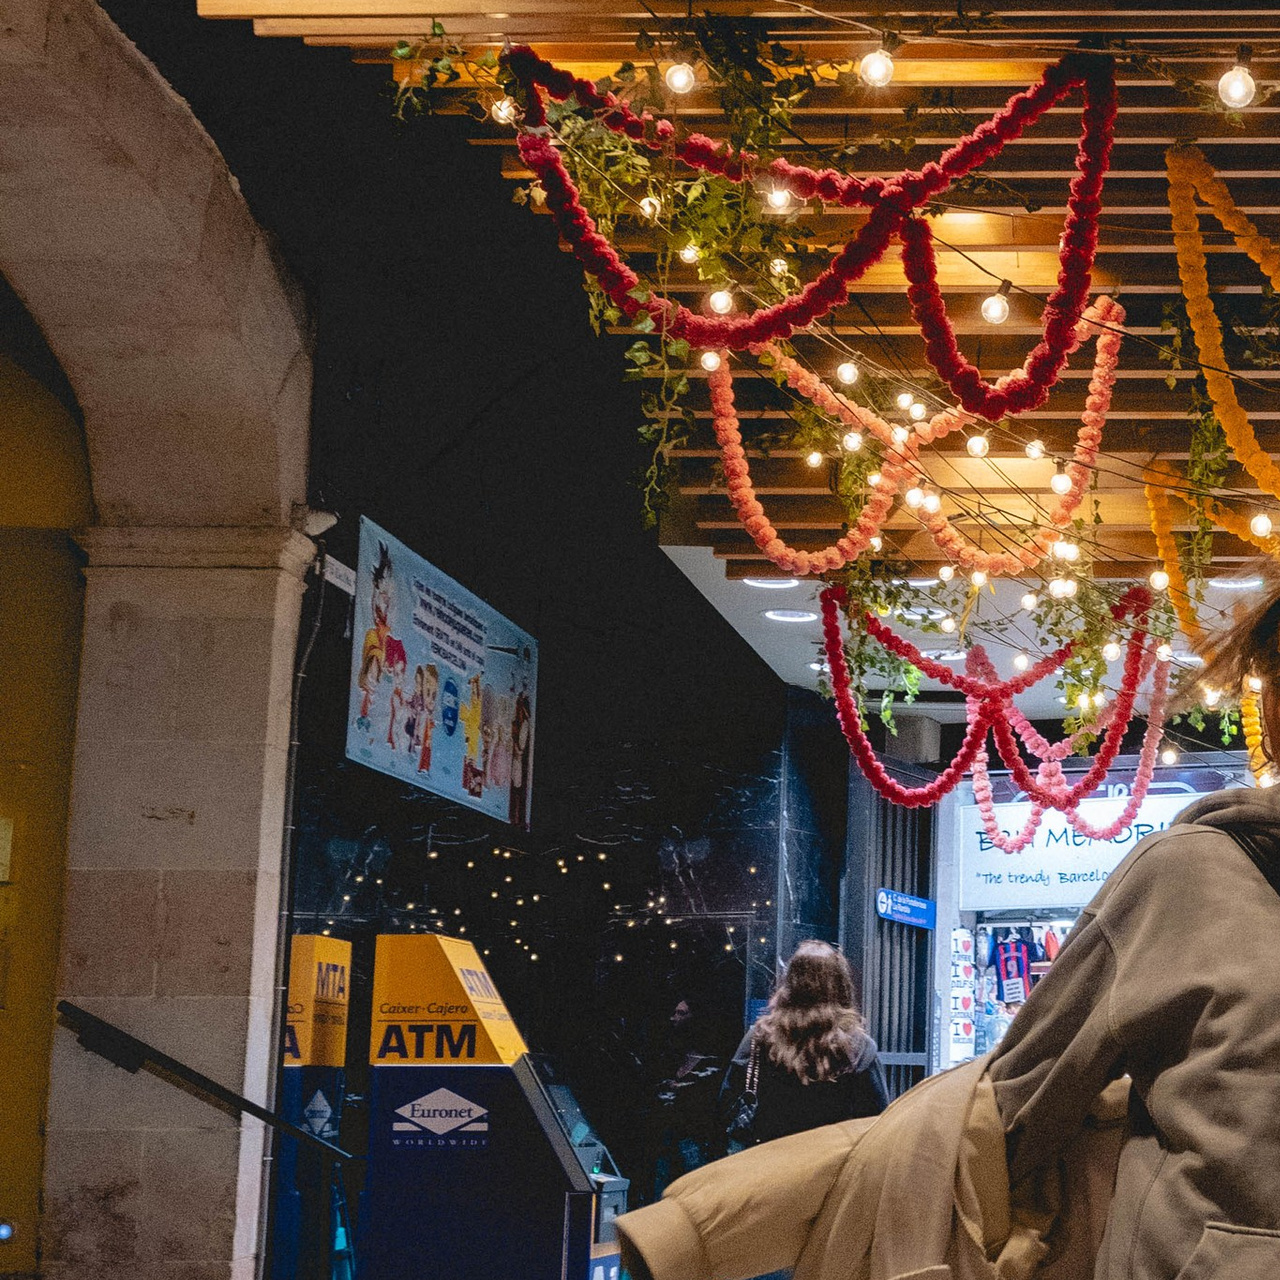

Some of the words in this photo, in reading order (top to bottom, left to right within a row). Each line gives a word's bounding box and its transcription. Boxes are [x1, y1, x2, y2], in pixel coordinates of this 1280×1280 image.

[1008, 870, 1051, 886] trendy
[1057, 869, 1111, 884] Barcelo
[460, 968, 499, 1000] ATM
[377, 1024, 477, 1059] ATM
[409, 1103, 473, 1119] Euronet
